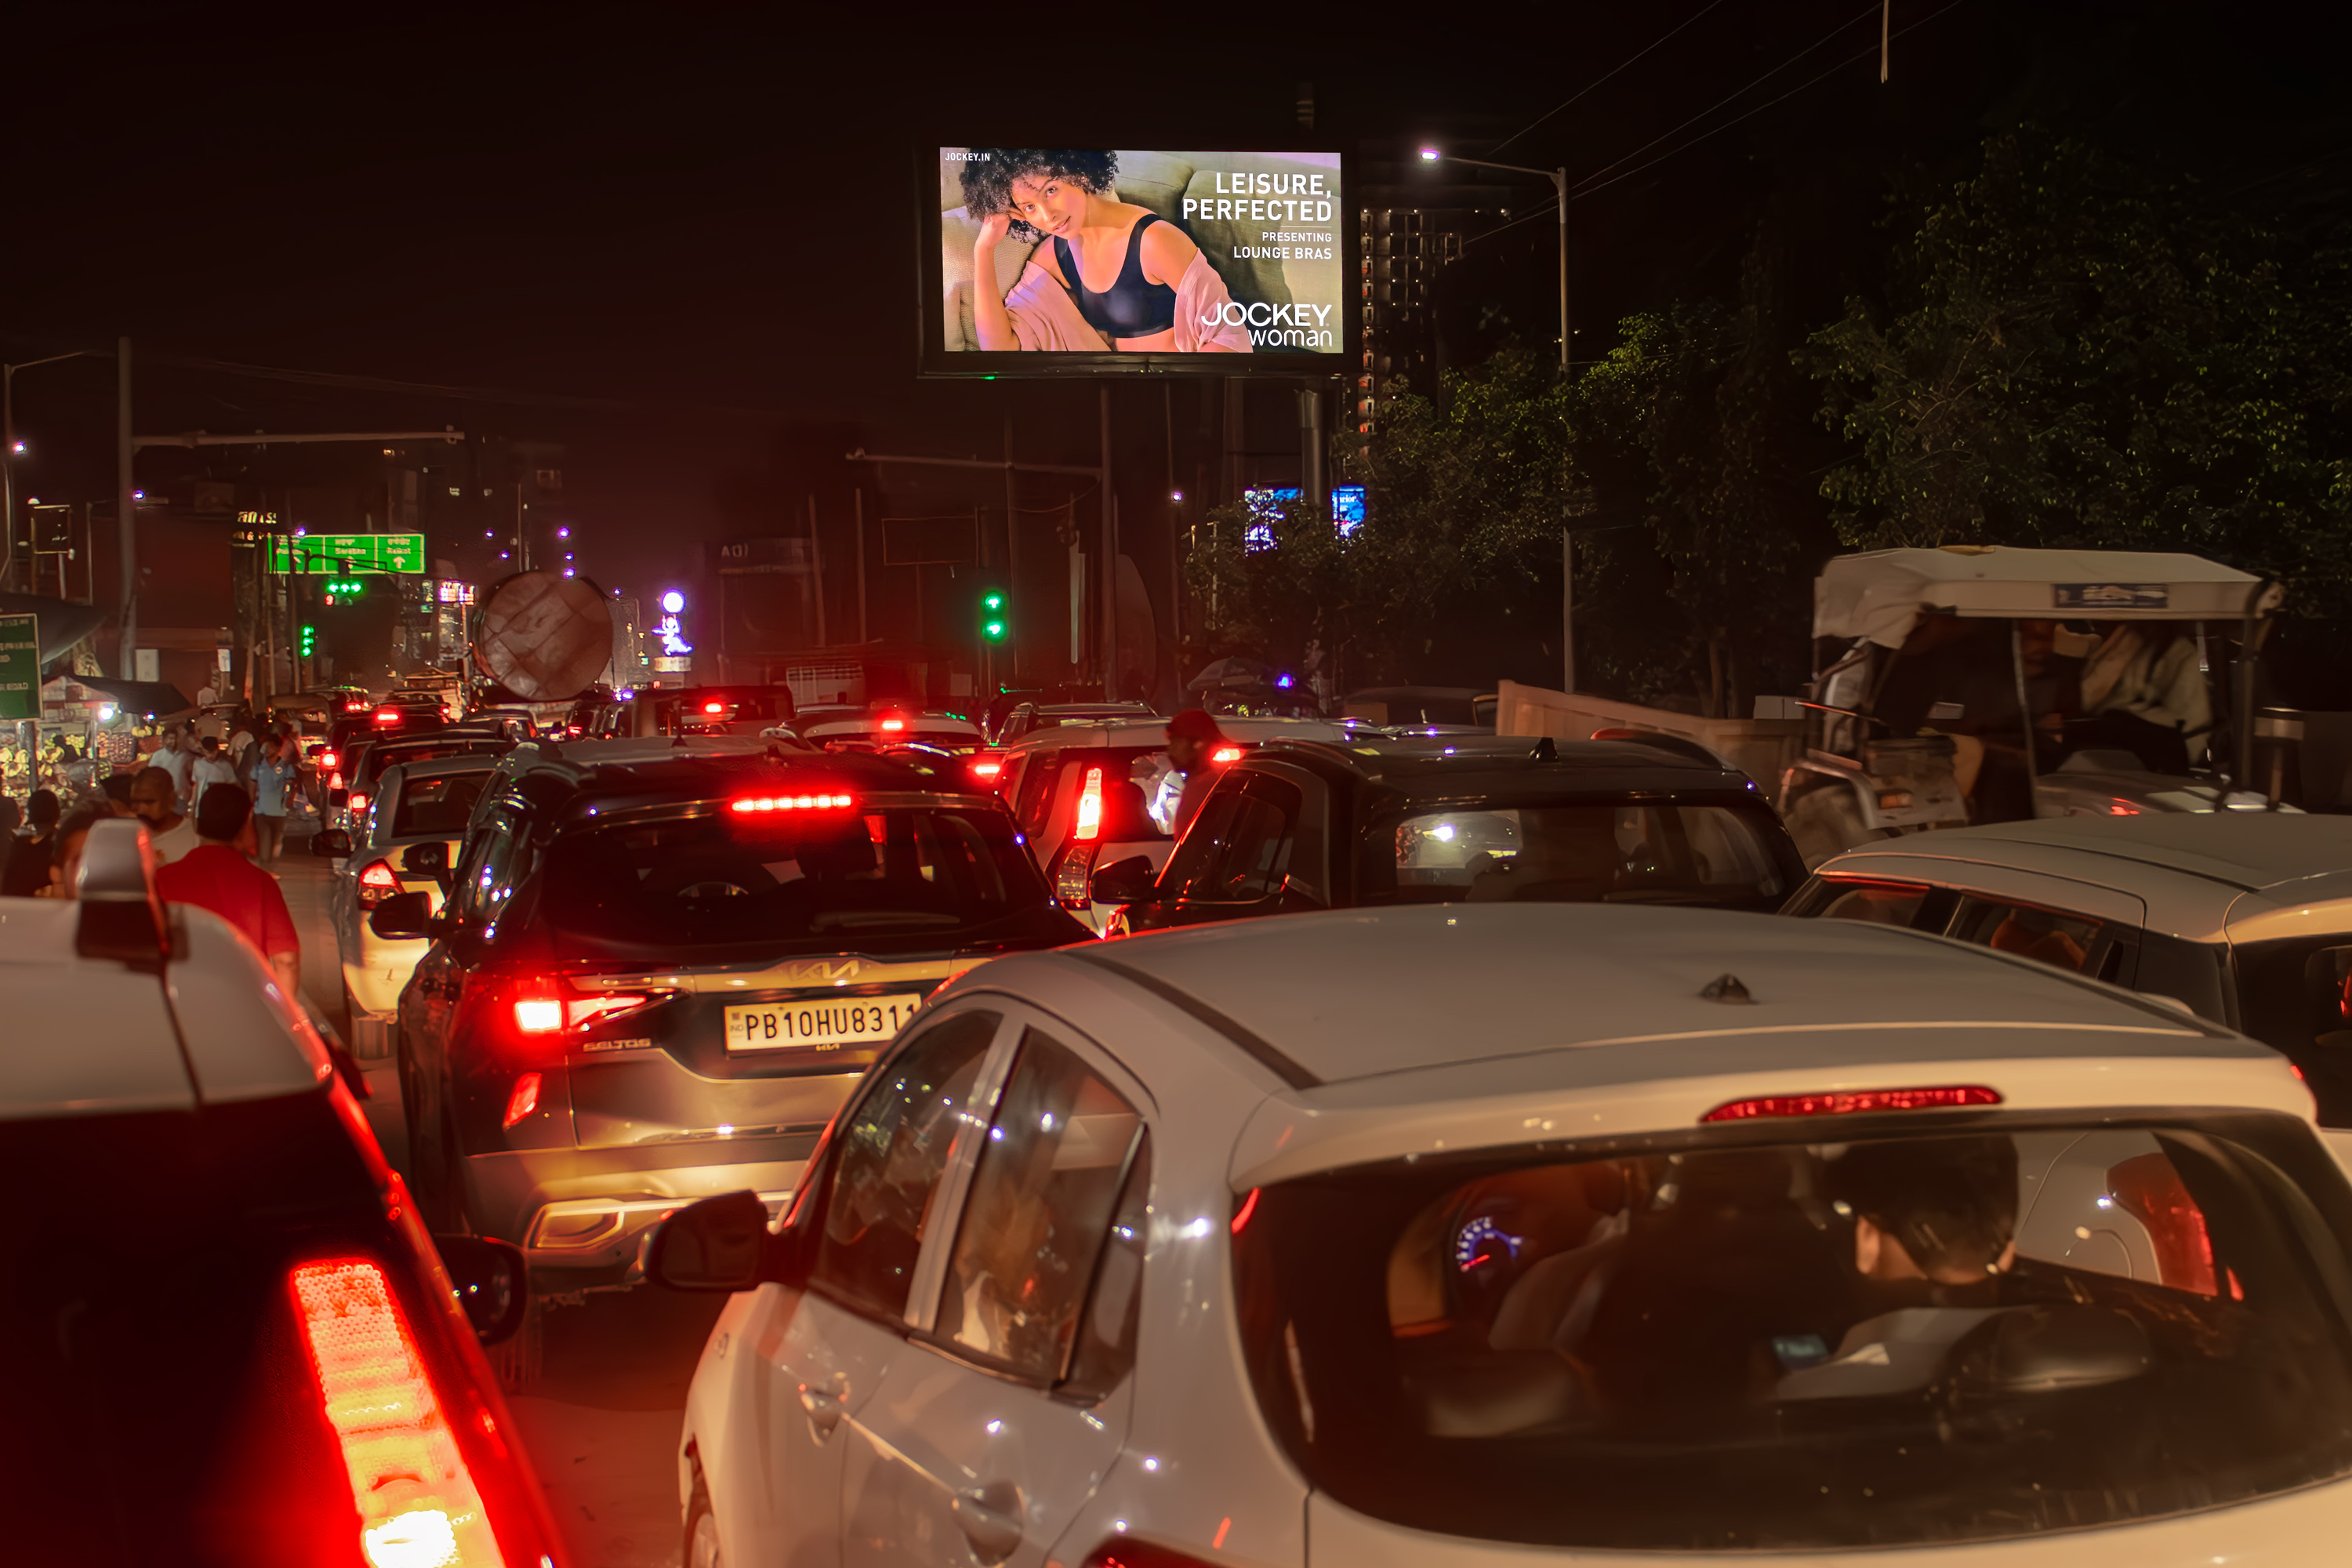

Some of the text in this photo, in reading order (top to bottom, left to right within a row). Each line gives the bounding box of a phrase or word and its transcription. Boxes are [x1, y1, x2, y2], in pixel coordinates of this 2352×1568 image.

[945, 152, 990, 162] JOCKEY.IN
[1216, 172, 1332, 200] LEISURE,
[1182, 198, 1332, 222] PERFECTED
[1261, 232, 1332, 242] PRESENTING
[1233, 246, 1332, 260] LOUNGE BRAS
[1200, 302, 1333, 327] JOCKEY
[1247, 329, 1333, 347] woman
